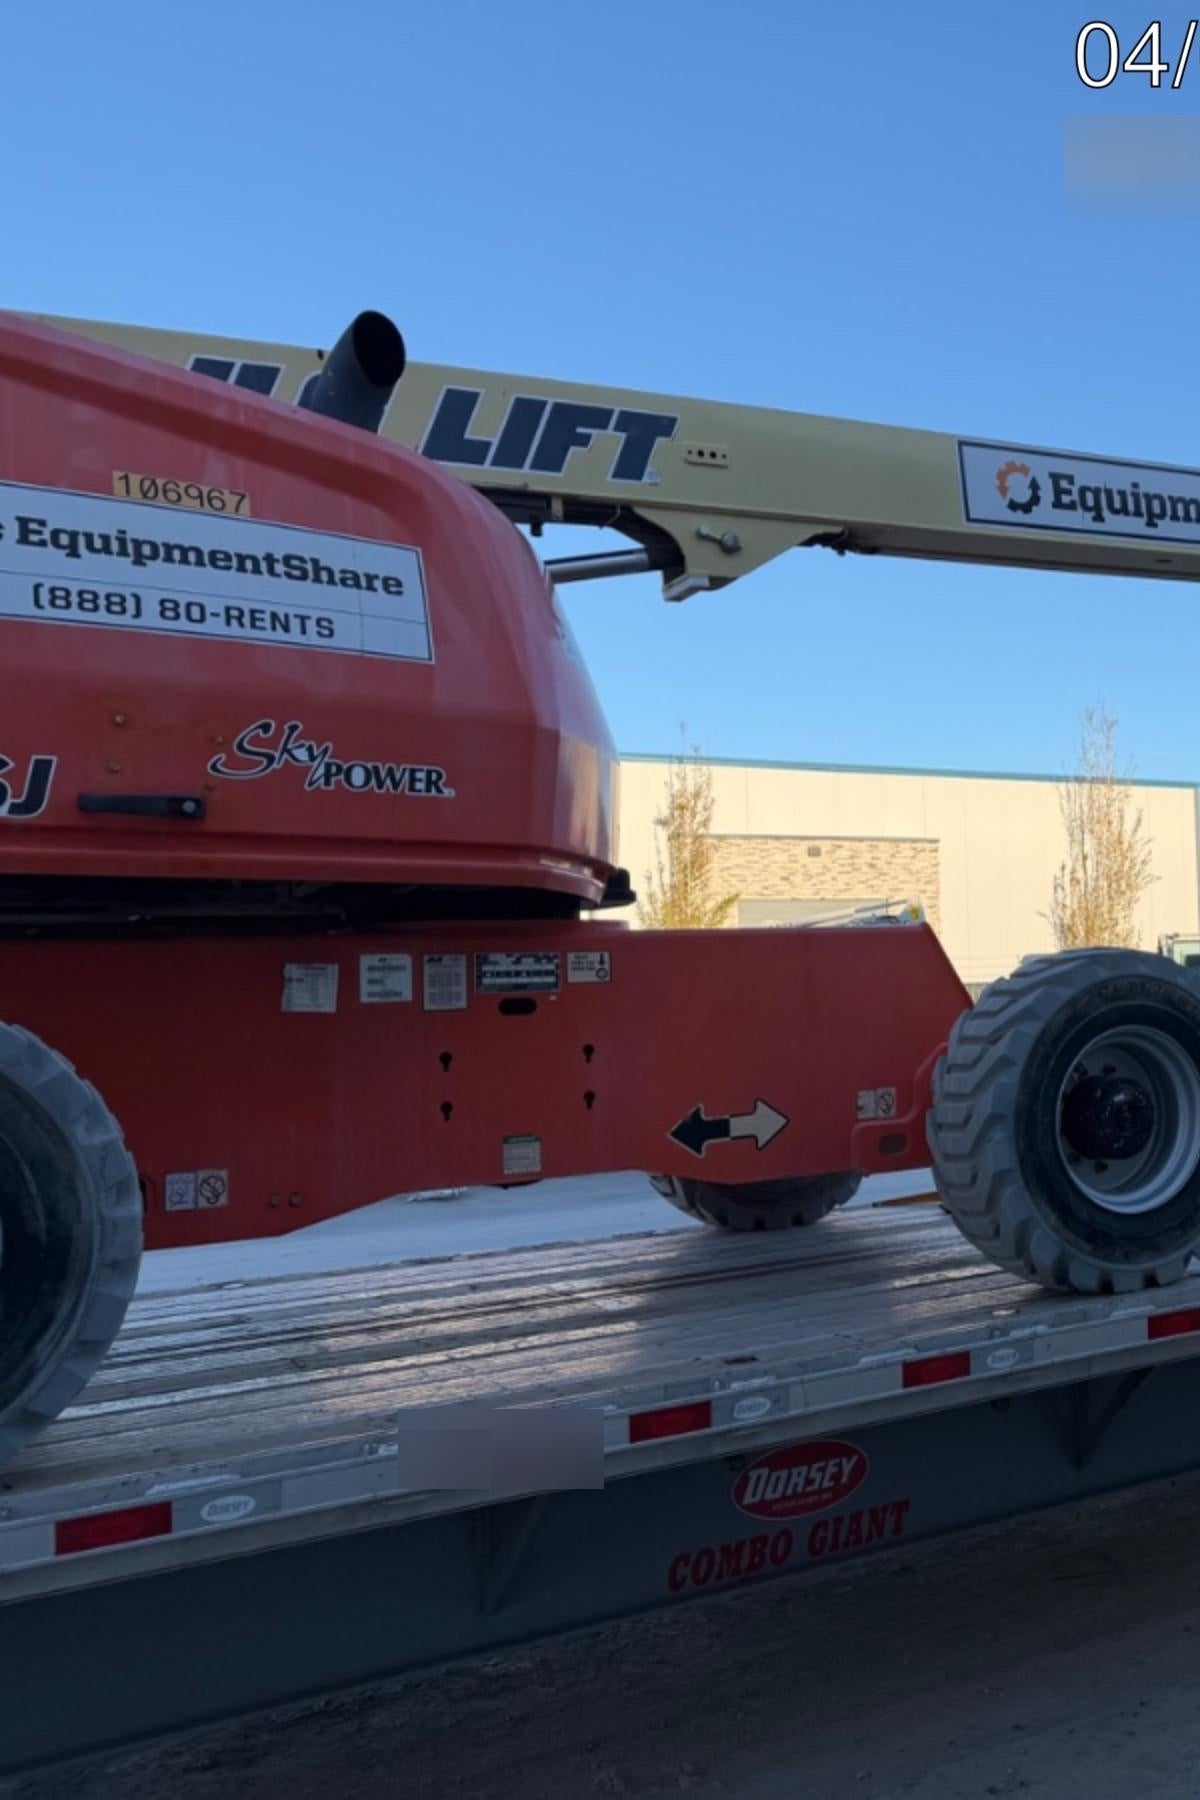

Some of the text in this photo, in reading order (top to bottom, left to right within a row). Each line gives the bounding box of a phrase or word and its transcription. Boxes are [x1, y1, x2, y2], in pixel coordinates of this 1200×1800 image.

[417, 386, 679, 483] LIFT
[118, 473, 247, 513] 106967
[14, 515, 404, 597] EquipmentShare
[33, 583, 335, 639] (888) 80-RENTS
[208, 720, 333, 790] Sky
[323, 760, 445, 796] POWER
[742, 1455, 859, 1505] DORSEY
[668, 1499, 911, 1592] COMBO GIANT
